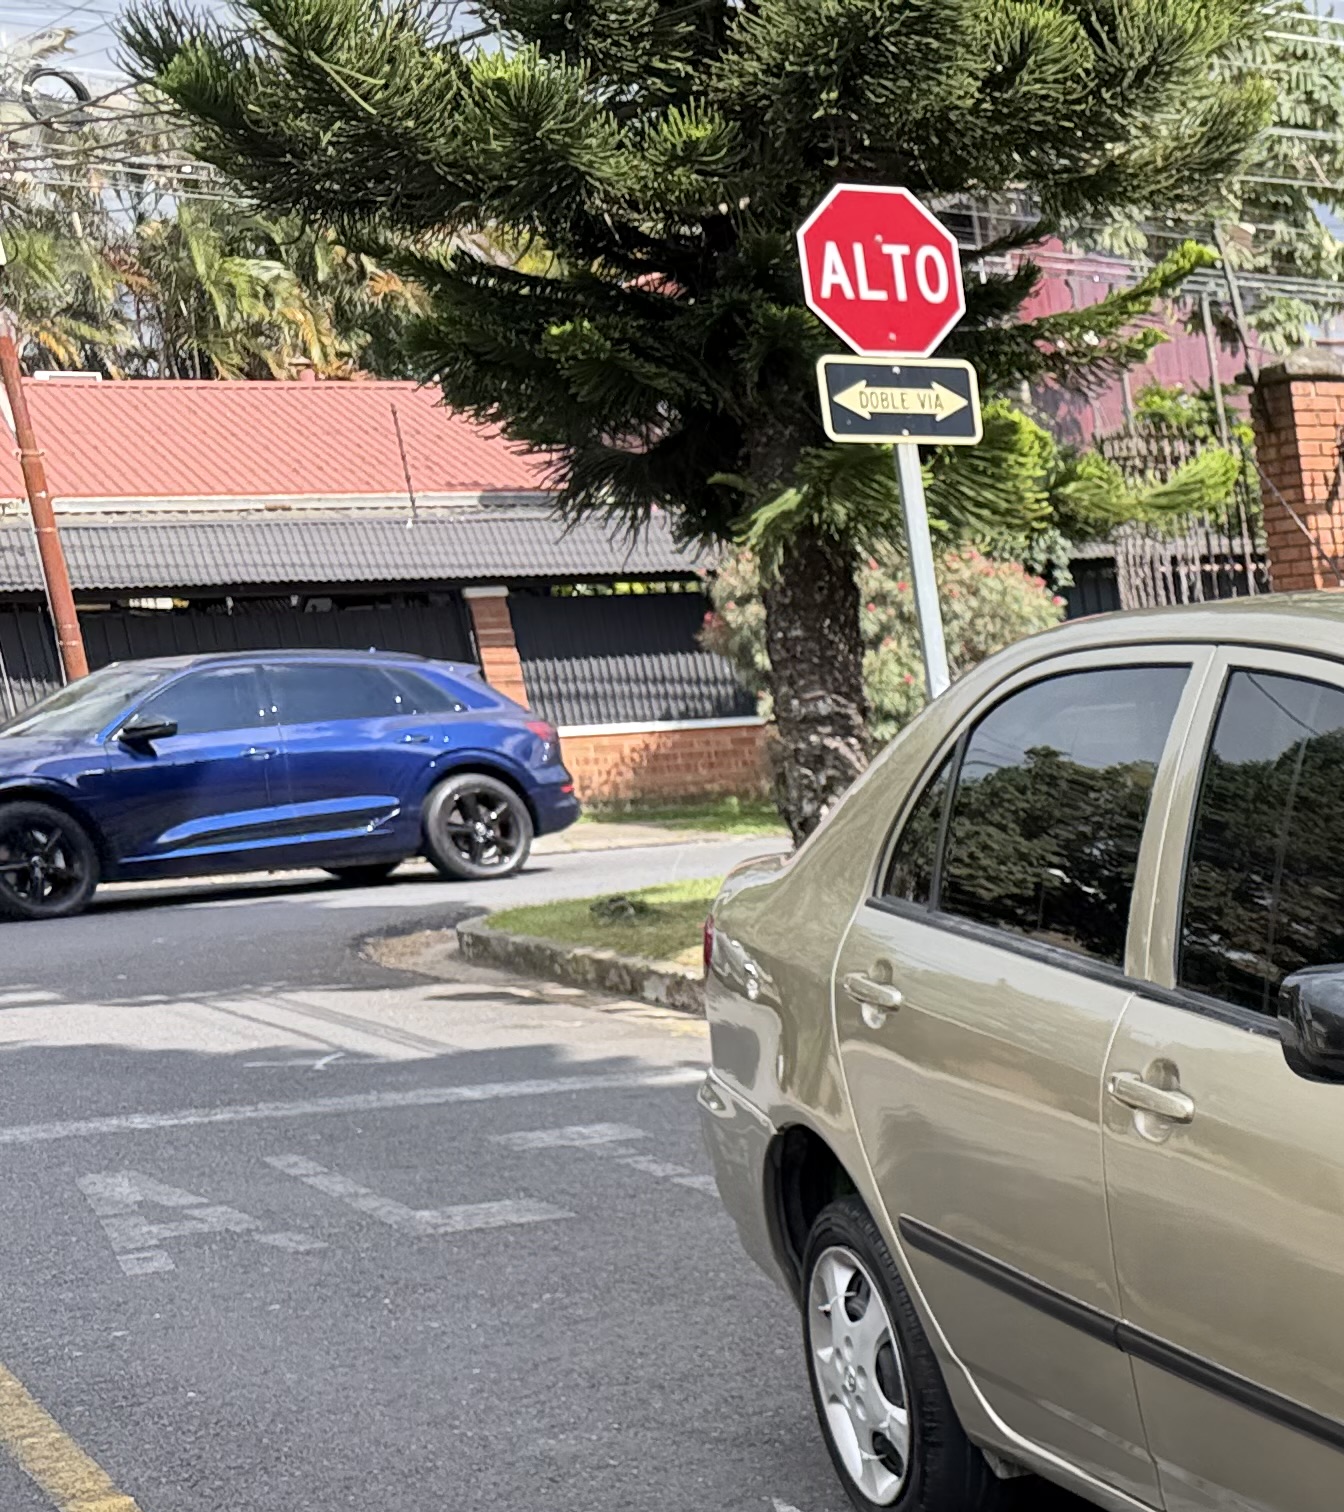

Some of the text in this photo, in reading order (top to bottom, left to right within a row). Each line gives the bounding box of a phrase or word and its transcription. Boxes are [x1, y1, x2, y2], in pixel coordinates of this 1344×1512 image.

[821, 241, 949, 304] ALTO
[859, 390, 944, 411] DOBLE VIA
